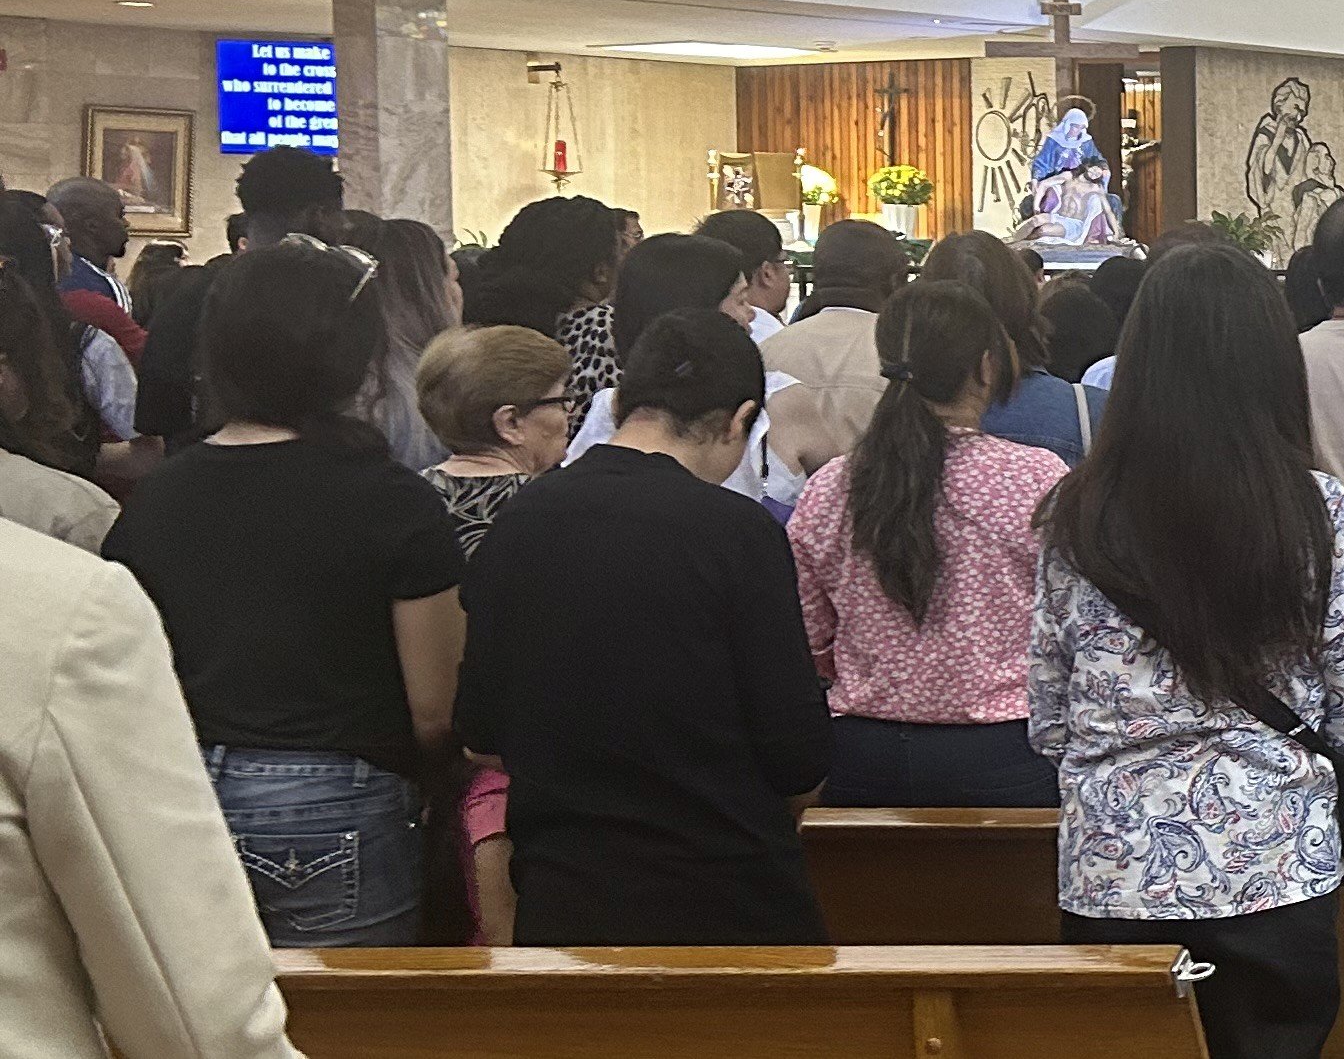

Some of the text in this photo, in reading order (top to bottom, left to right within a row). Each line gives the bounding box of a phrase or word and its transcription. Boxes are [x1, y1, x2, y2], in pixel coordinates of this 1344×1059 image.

[252, 44, 331, 60] Let us make
[263, 63, 336, 78] to the cross
[222, 79, 332, 95] who surrendered
[268, 98, 335, 112] to become
[268, 115, 338, 130] of the grea
